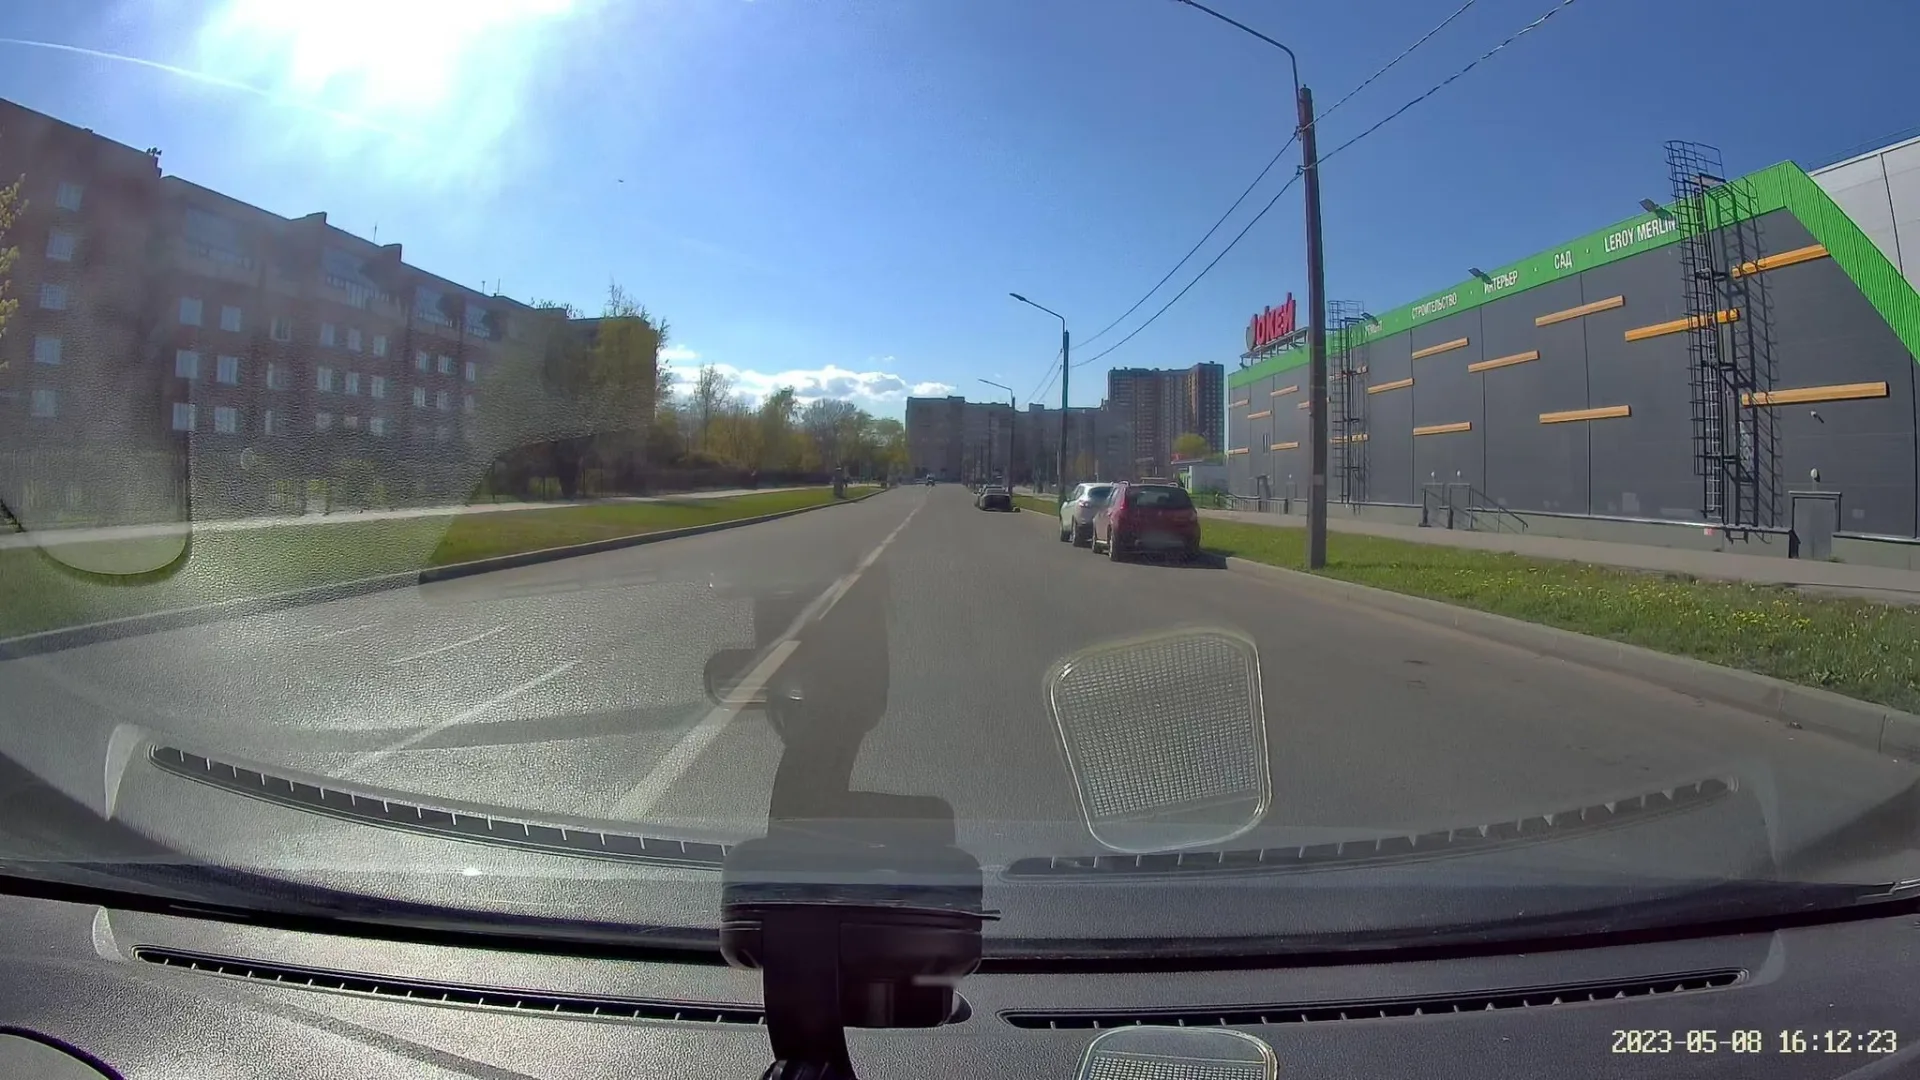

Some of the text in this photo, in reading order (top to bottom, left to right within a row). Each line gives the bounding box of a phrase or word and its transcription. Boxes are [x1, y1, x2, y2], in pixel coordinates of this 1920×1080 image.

[1604, 217, 1676, 252] LEROY MERLIN
[1554, 250, 1573, 270] САД
